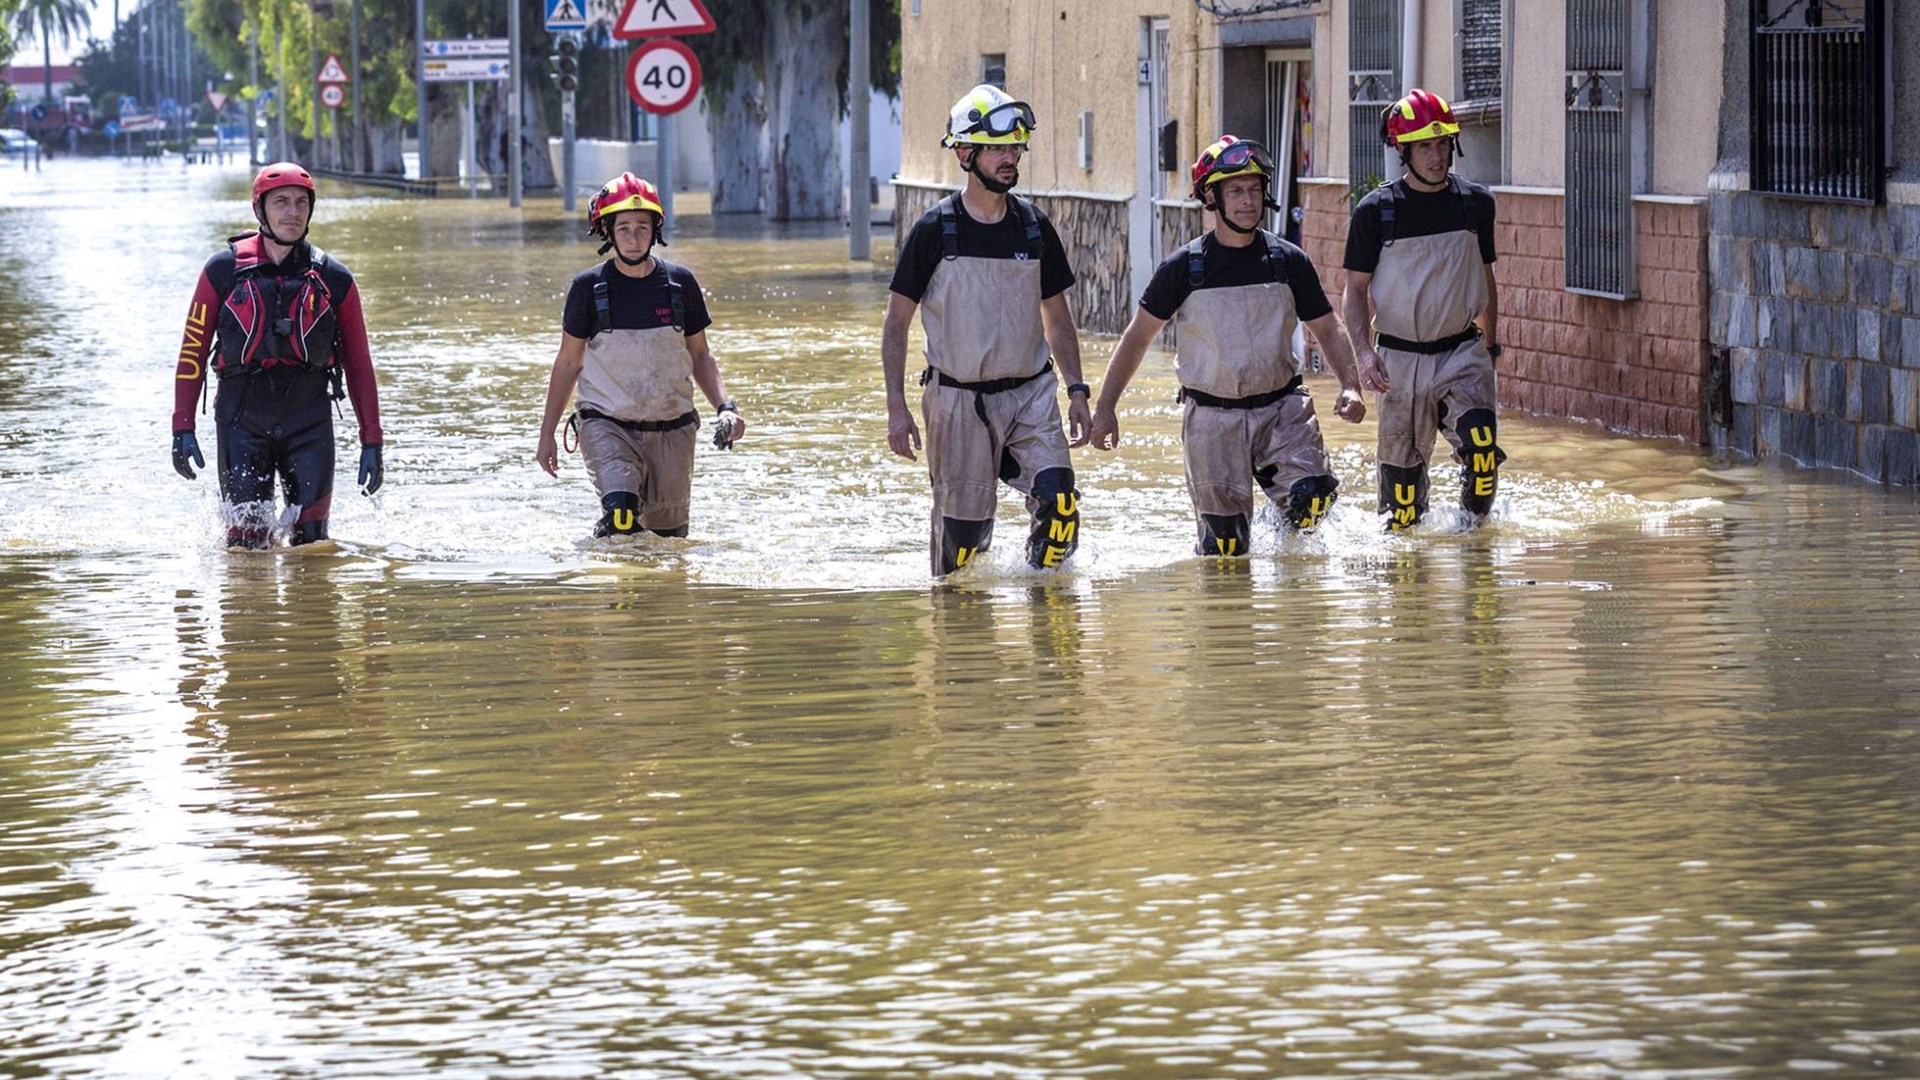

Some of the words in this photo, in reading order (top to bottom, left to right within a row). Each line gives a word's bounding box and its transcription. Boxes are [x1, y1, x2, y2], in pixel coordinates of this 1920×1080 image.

[643, 65, 685, 89] 40
[1140, 62, 1149, 80] 4
[177, 303, 207, 379] UME
[1470, 426, 1496, 496] UME
[613, 508, 633, 530] U
[1043, 493, 1076, 567] UME
